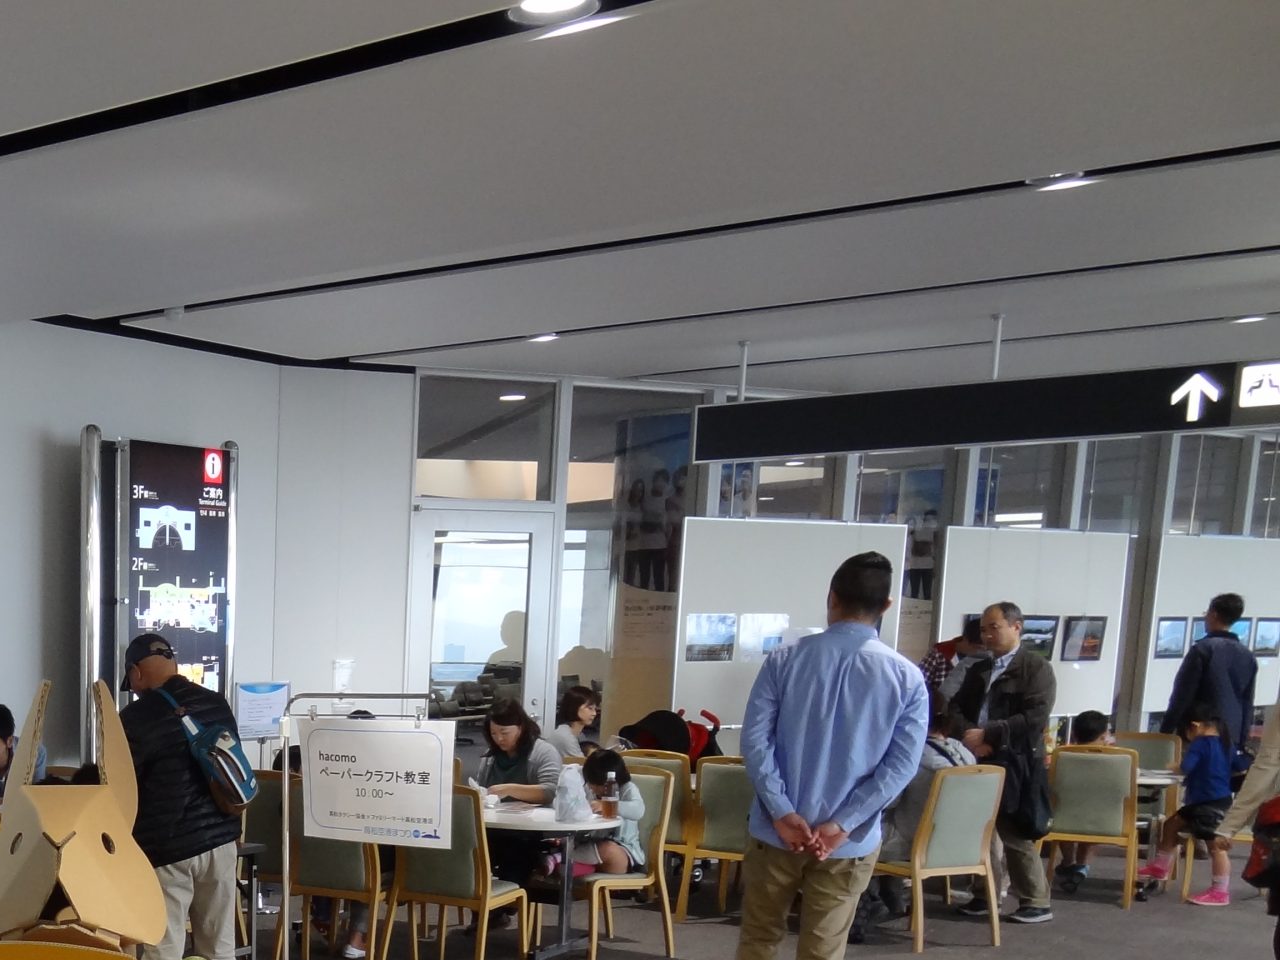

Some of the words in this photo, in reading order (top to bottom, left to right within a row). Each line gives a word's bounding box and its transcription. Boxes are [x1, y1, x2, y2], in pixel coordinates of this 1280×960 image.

[203, 487, 223, 499] ご案内
[319, 751, 357, 763] hacomo
[320, 767, 431, 785] ペーパークラフト教室
